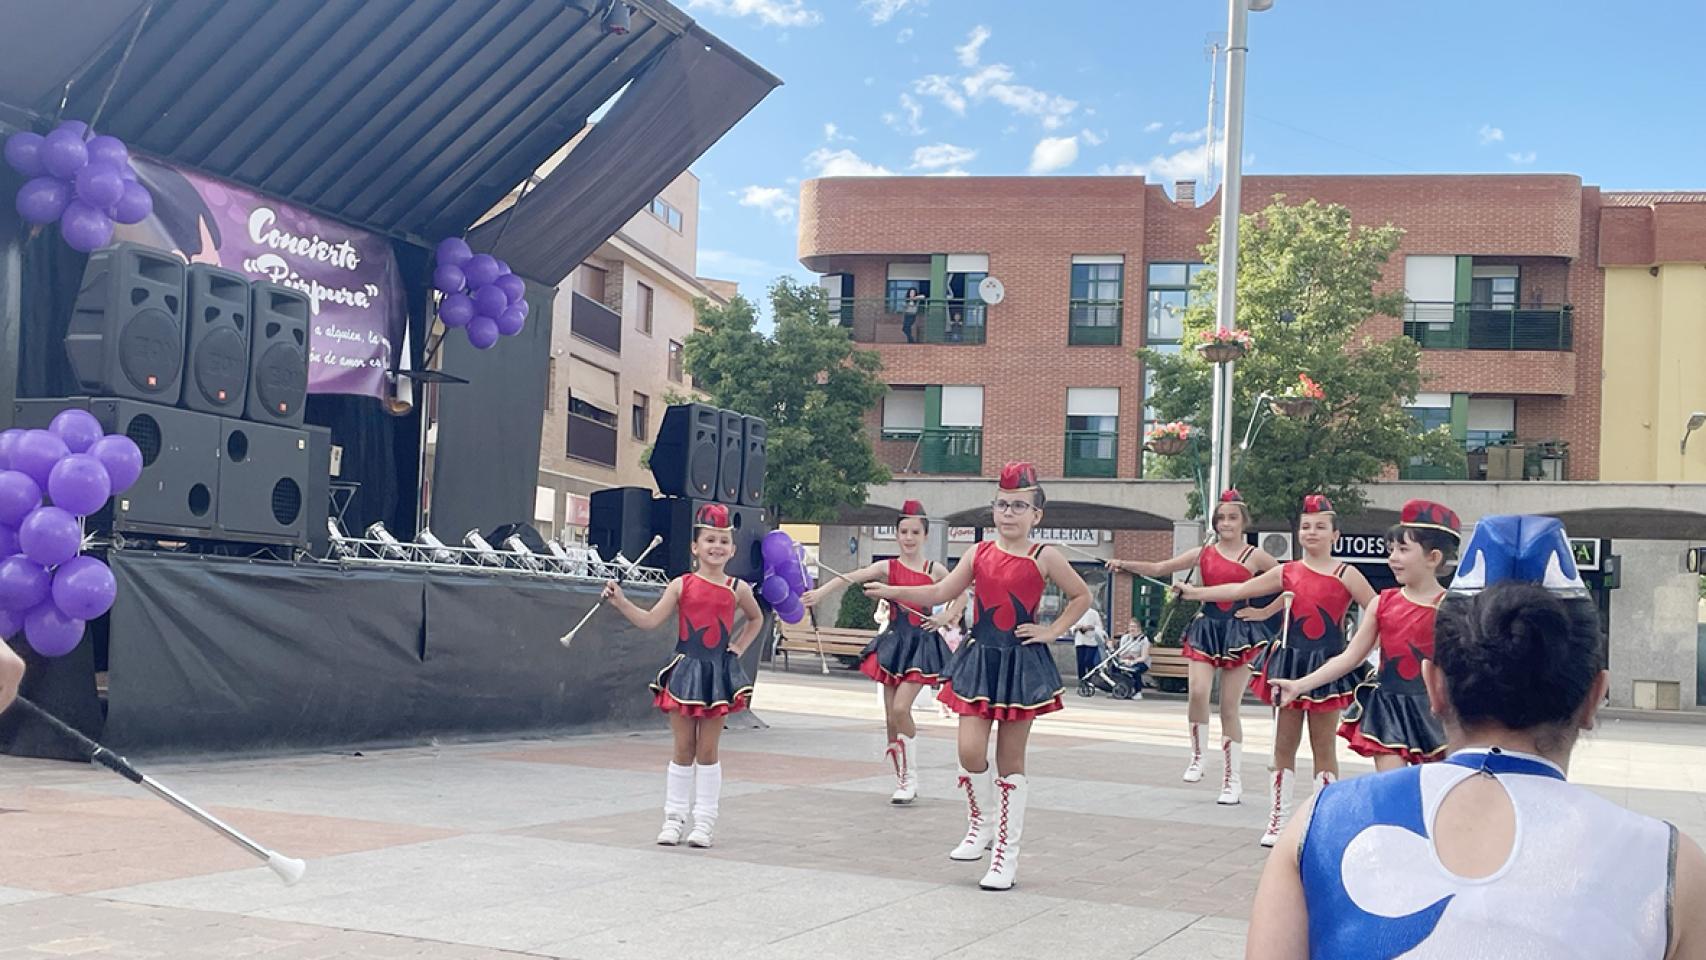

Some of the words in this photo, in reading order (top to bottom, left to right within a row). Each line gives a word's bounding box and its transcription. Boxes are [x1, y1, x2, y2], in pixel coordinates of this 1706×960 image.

[249, 207, 361, 271] Concierto
[324, 350, 336, 365] de
[340, 356, 367, 368] amor
[1334, 536, 1390, 555] UTOES
